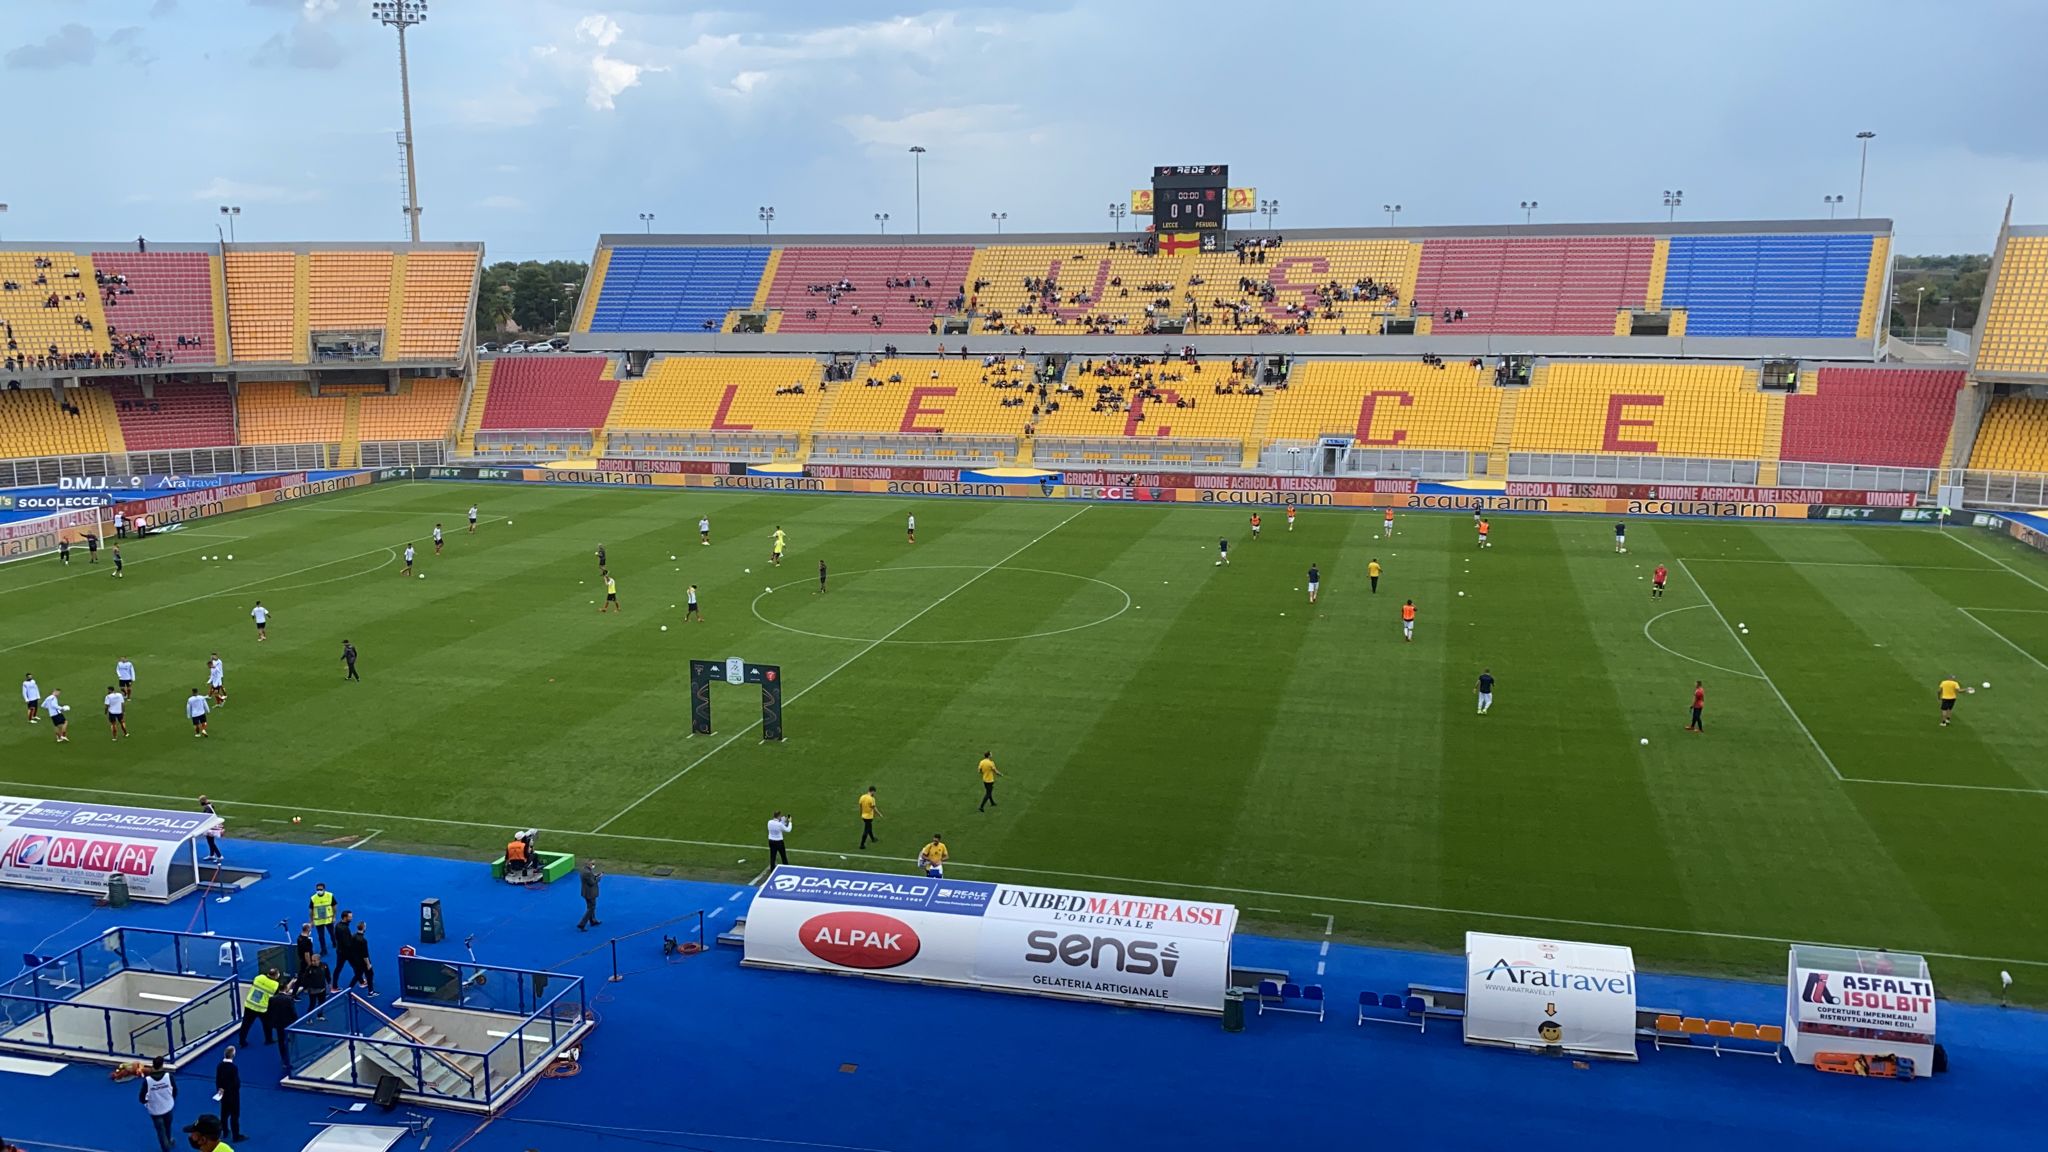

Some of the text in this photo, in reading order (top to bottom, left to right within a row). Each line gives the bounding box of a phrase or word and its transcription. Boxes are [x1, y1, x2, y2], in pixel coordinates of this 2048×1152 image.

[1171, 203, 1178, 218] 0
[1197, 203, 1204, 218] 0
[381, 469, 408, 479] BKT
[430, 468, 461, 476] BKT
[478, 469, 509, 478] BKT
[599, 460, 632, 471] GRICOLA
[634, 460, 681, 473] MELISSANO
[843, 467, 891, 479] MELISSANO
[923, 469, 954, 481] UNIONE
[60, 477, 108, 489] D.M.J.
[157, 476, 221, 488] Aratravel
[1194, 476, 1229, 488] UNIONE
[1231, 476, 1277, 490] AGRICOLA
[1281, 478, 1336, 491] MELISSANO
[1374, 480, 1409, 493] UNIONE
[177, 489, 214, 507] AGRICOLA
[216, 482, 256, 500] MELISSANO
[1069, 487, 1134, 499] LECCE
[1556, 484, 1617, 498] MELISSANO
[1658, 487, 1698, 500] UNIONE
[1701, 488, 1754, 502] AGRICOLA
[1758, 489, 1823, 504] MELISSANO
[1866, 492, 1909, 506] UNIONE
[19, 497, 107, 507] SOLOLECCE.it
[1827, 507, 1874, 517] BKT
[94, 813, 200, 830] CAROFALO
[801, 877, 929, 896] CAROFALO
[814, 926, 902, 950] ALPAK
[1485, 958, 1632, 995] Aratravel
[1033, 975, 1169, 998] GELATERIA ARTIGIANALE
[1485, 984, 1555, 997] WWW.ARATRAVEL.IT
[1843, 975, 1931, 996] ASFALTI
[1843, 991, 1932, 1014] ISOLBIT
[1817, 1006, 1917, 1022] COPERTURE IMPERMEABILI
[1820, 1014, 1914, 1029] RISTRUTTURAZIONI EDILI
